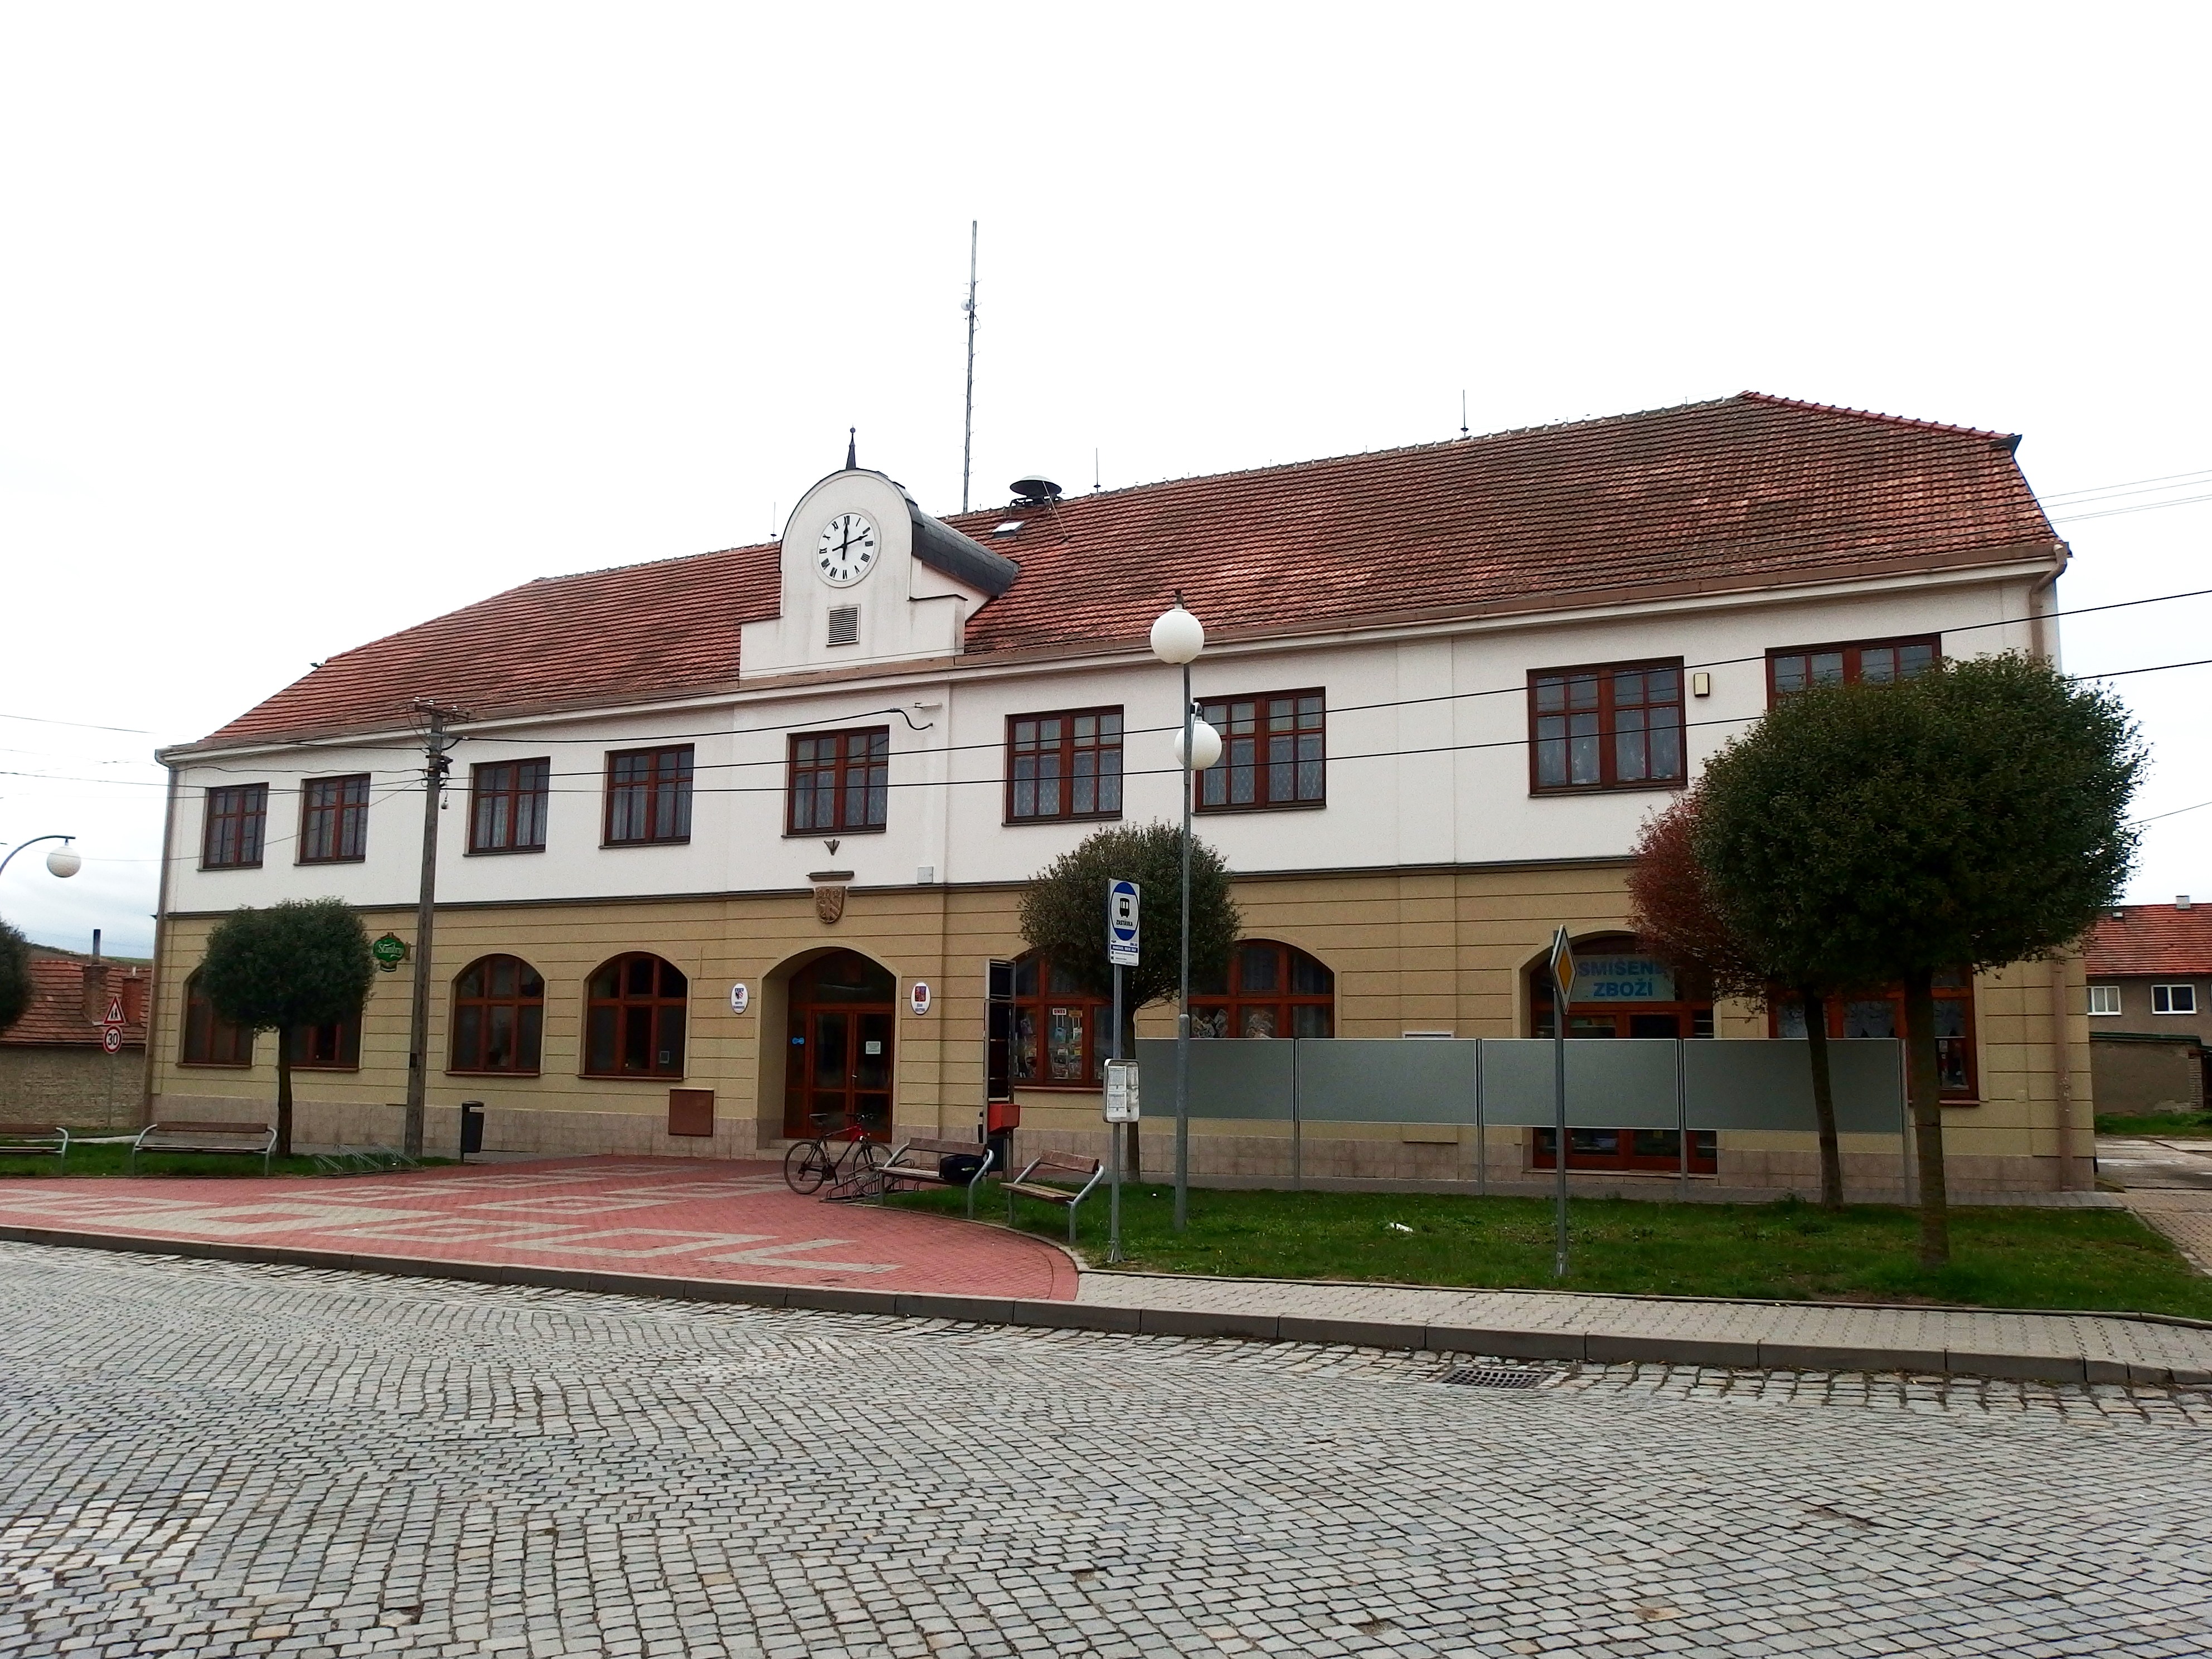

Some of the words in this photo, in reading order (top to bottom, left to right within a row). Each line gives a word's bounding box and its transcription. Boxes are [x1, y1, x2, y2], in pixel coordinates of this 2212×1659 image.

[856, 518, 861, 527] I
[854, 565, 860, 574] V
[1593, 978, 1653, 997] ZBOŽÍ
[108, 1033, 118, 1046] 30
